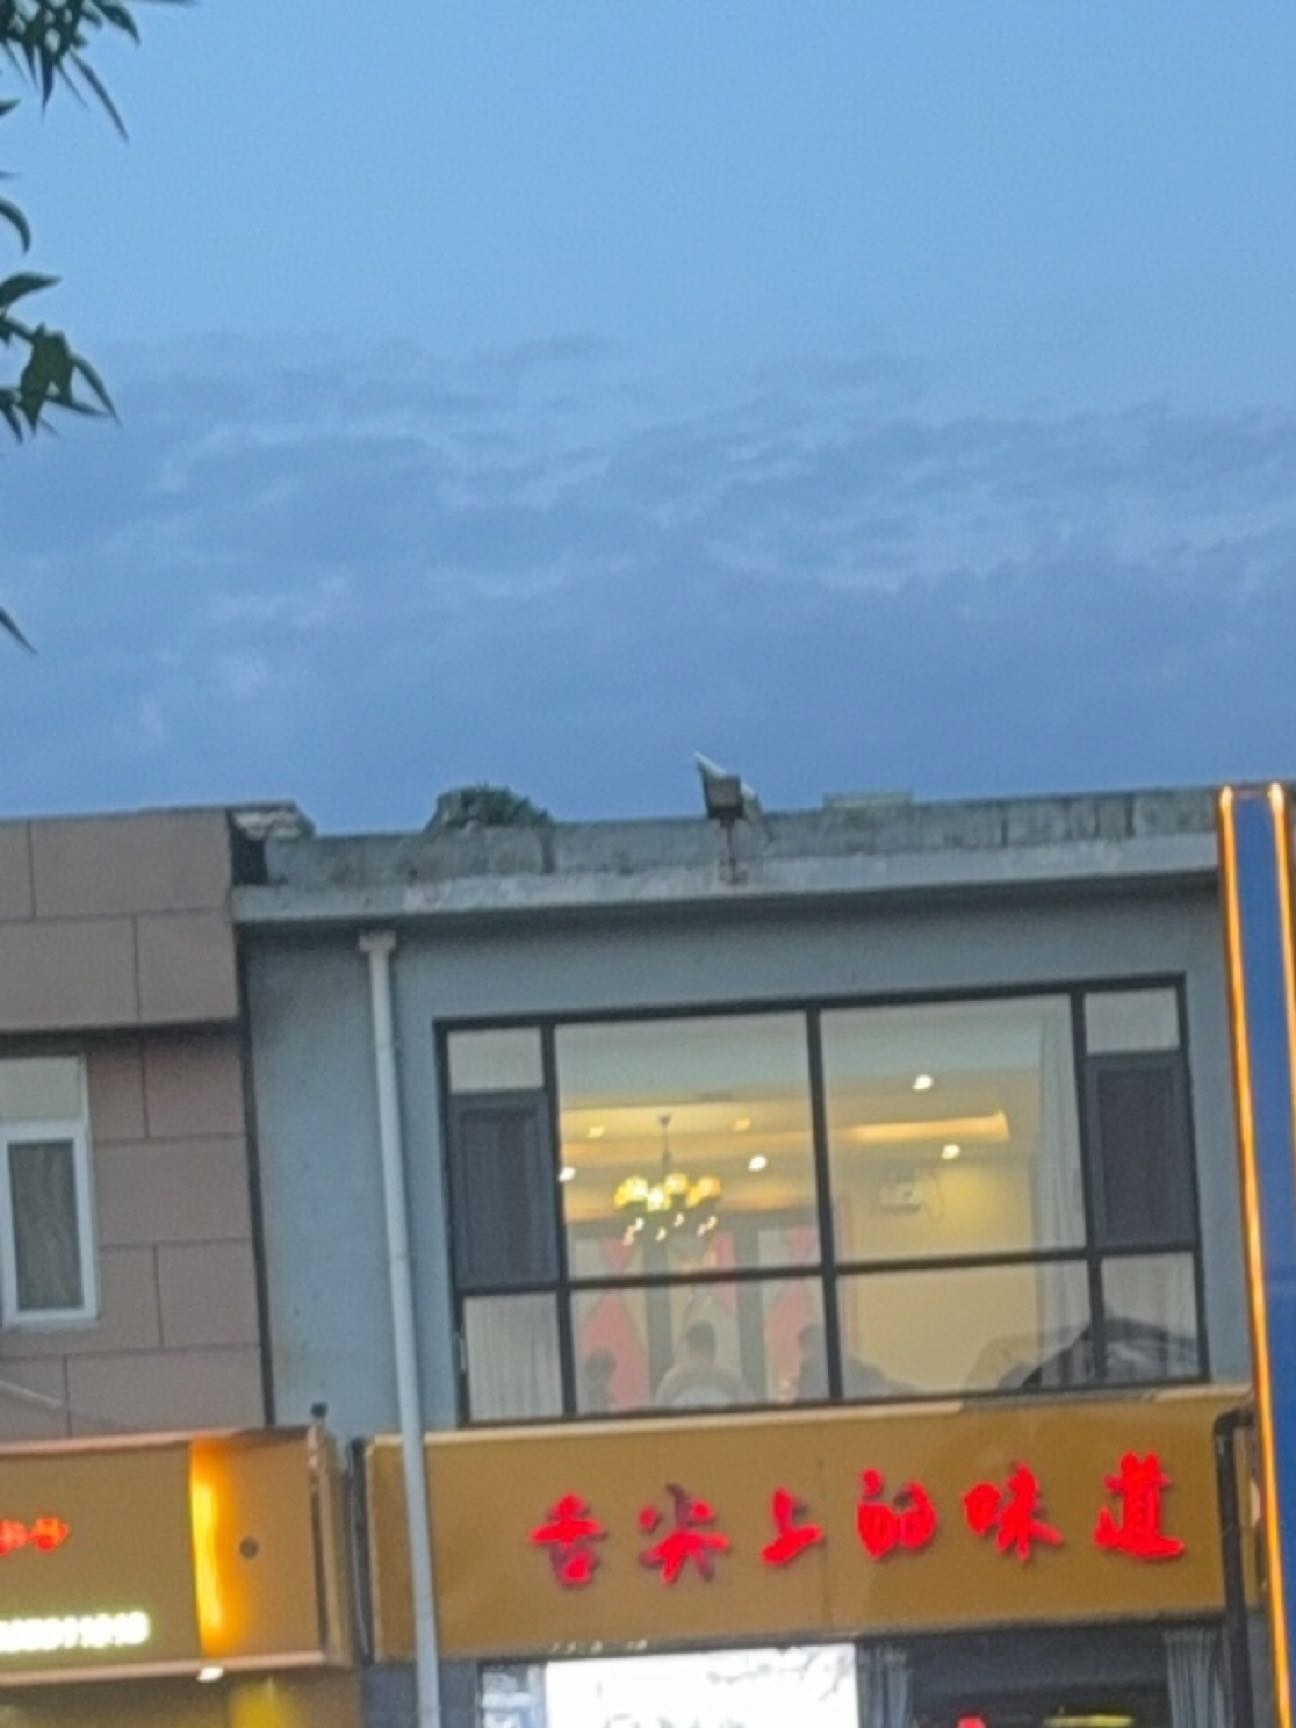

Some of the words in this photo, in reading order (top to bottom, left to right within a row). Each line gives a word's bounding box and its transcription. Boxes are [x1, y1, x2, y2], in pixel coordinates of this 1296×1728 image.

[530, 1451, 1186, 1586] 舌尖上的味道
